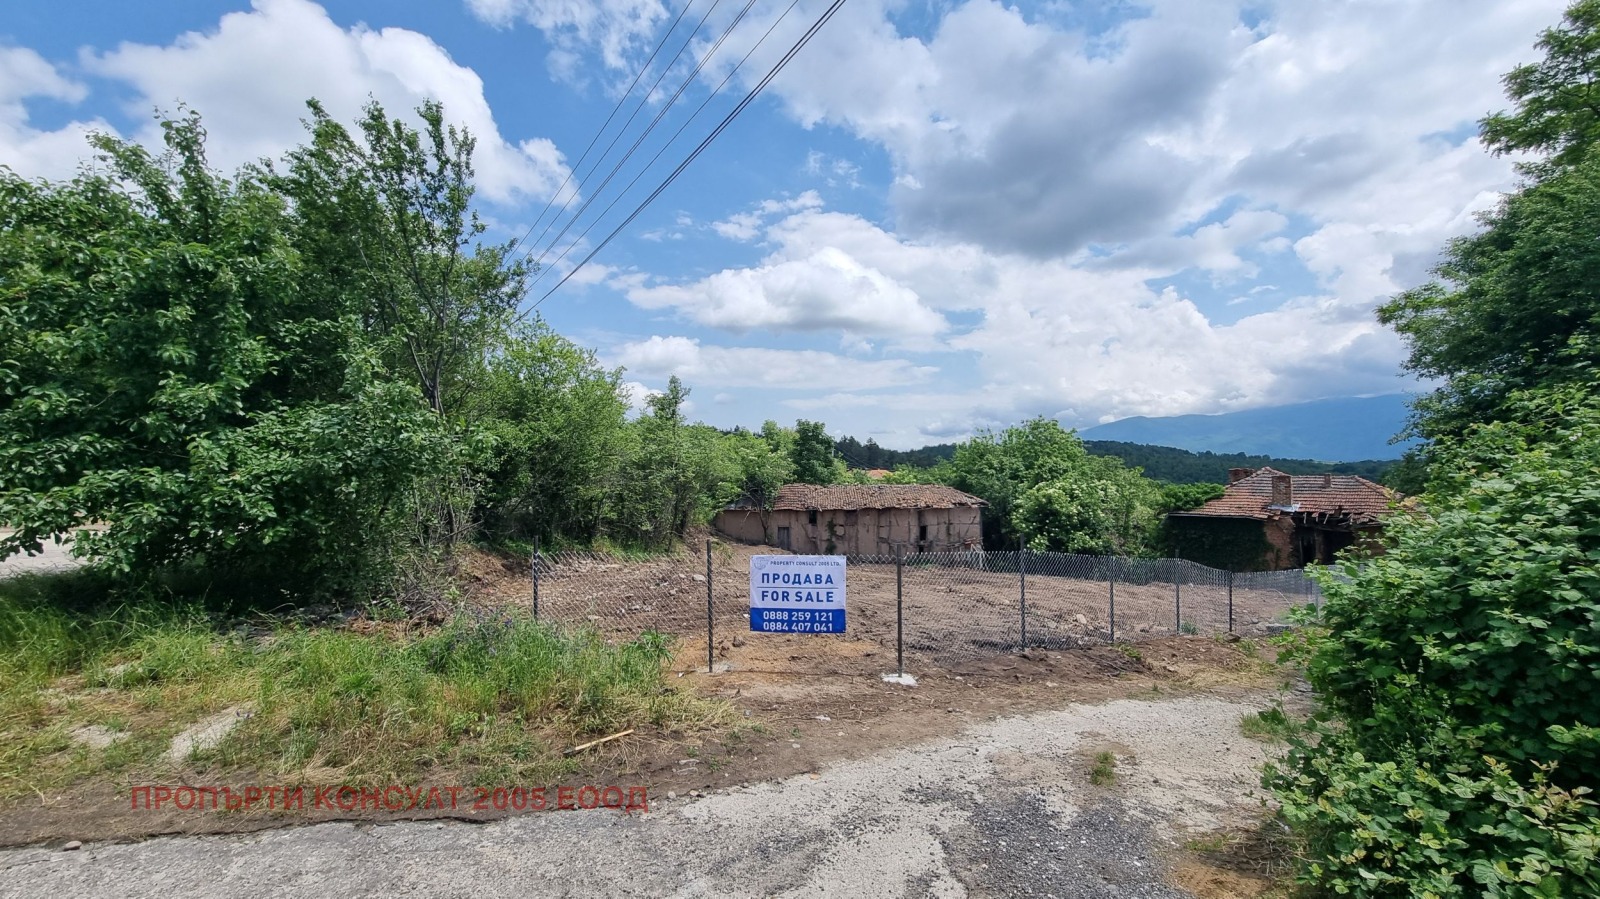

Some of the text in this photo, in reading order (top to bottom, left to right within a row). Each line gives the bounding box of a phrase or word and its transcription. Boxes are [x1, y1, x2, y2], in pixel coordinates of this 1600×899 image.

[761, 573, 834, 585] ПРОДАВА
[761, 590, 834, 602] FOR SALE
[763, 611, 832, 620] 0888 259 121
[763, 622, 832, 631] 0884 407 041
